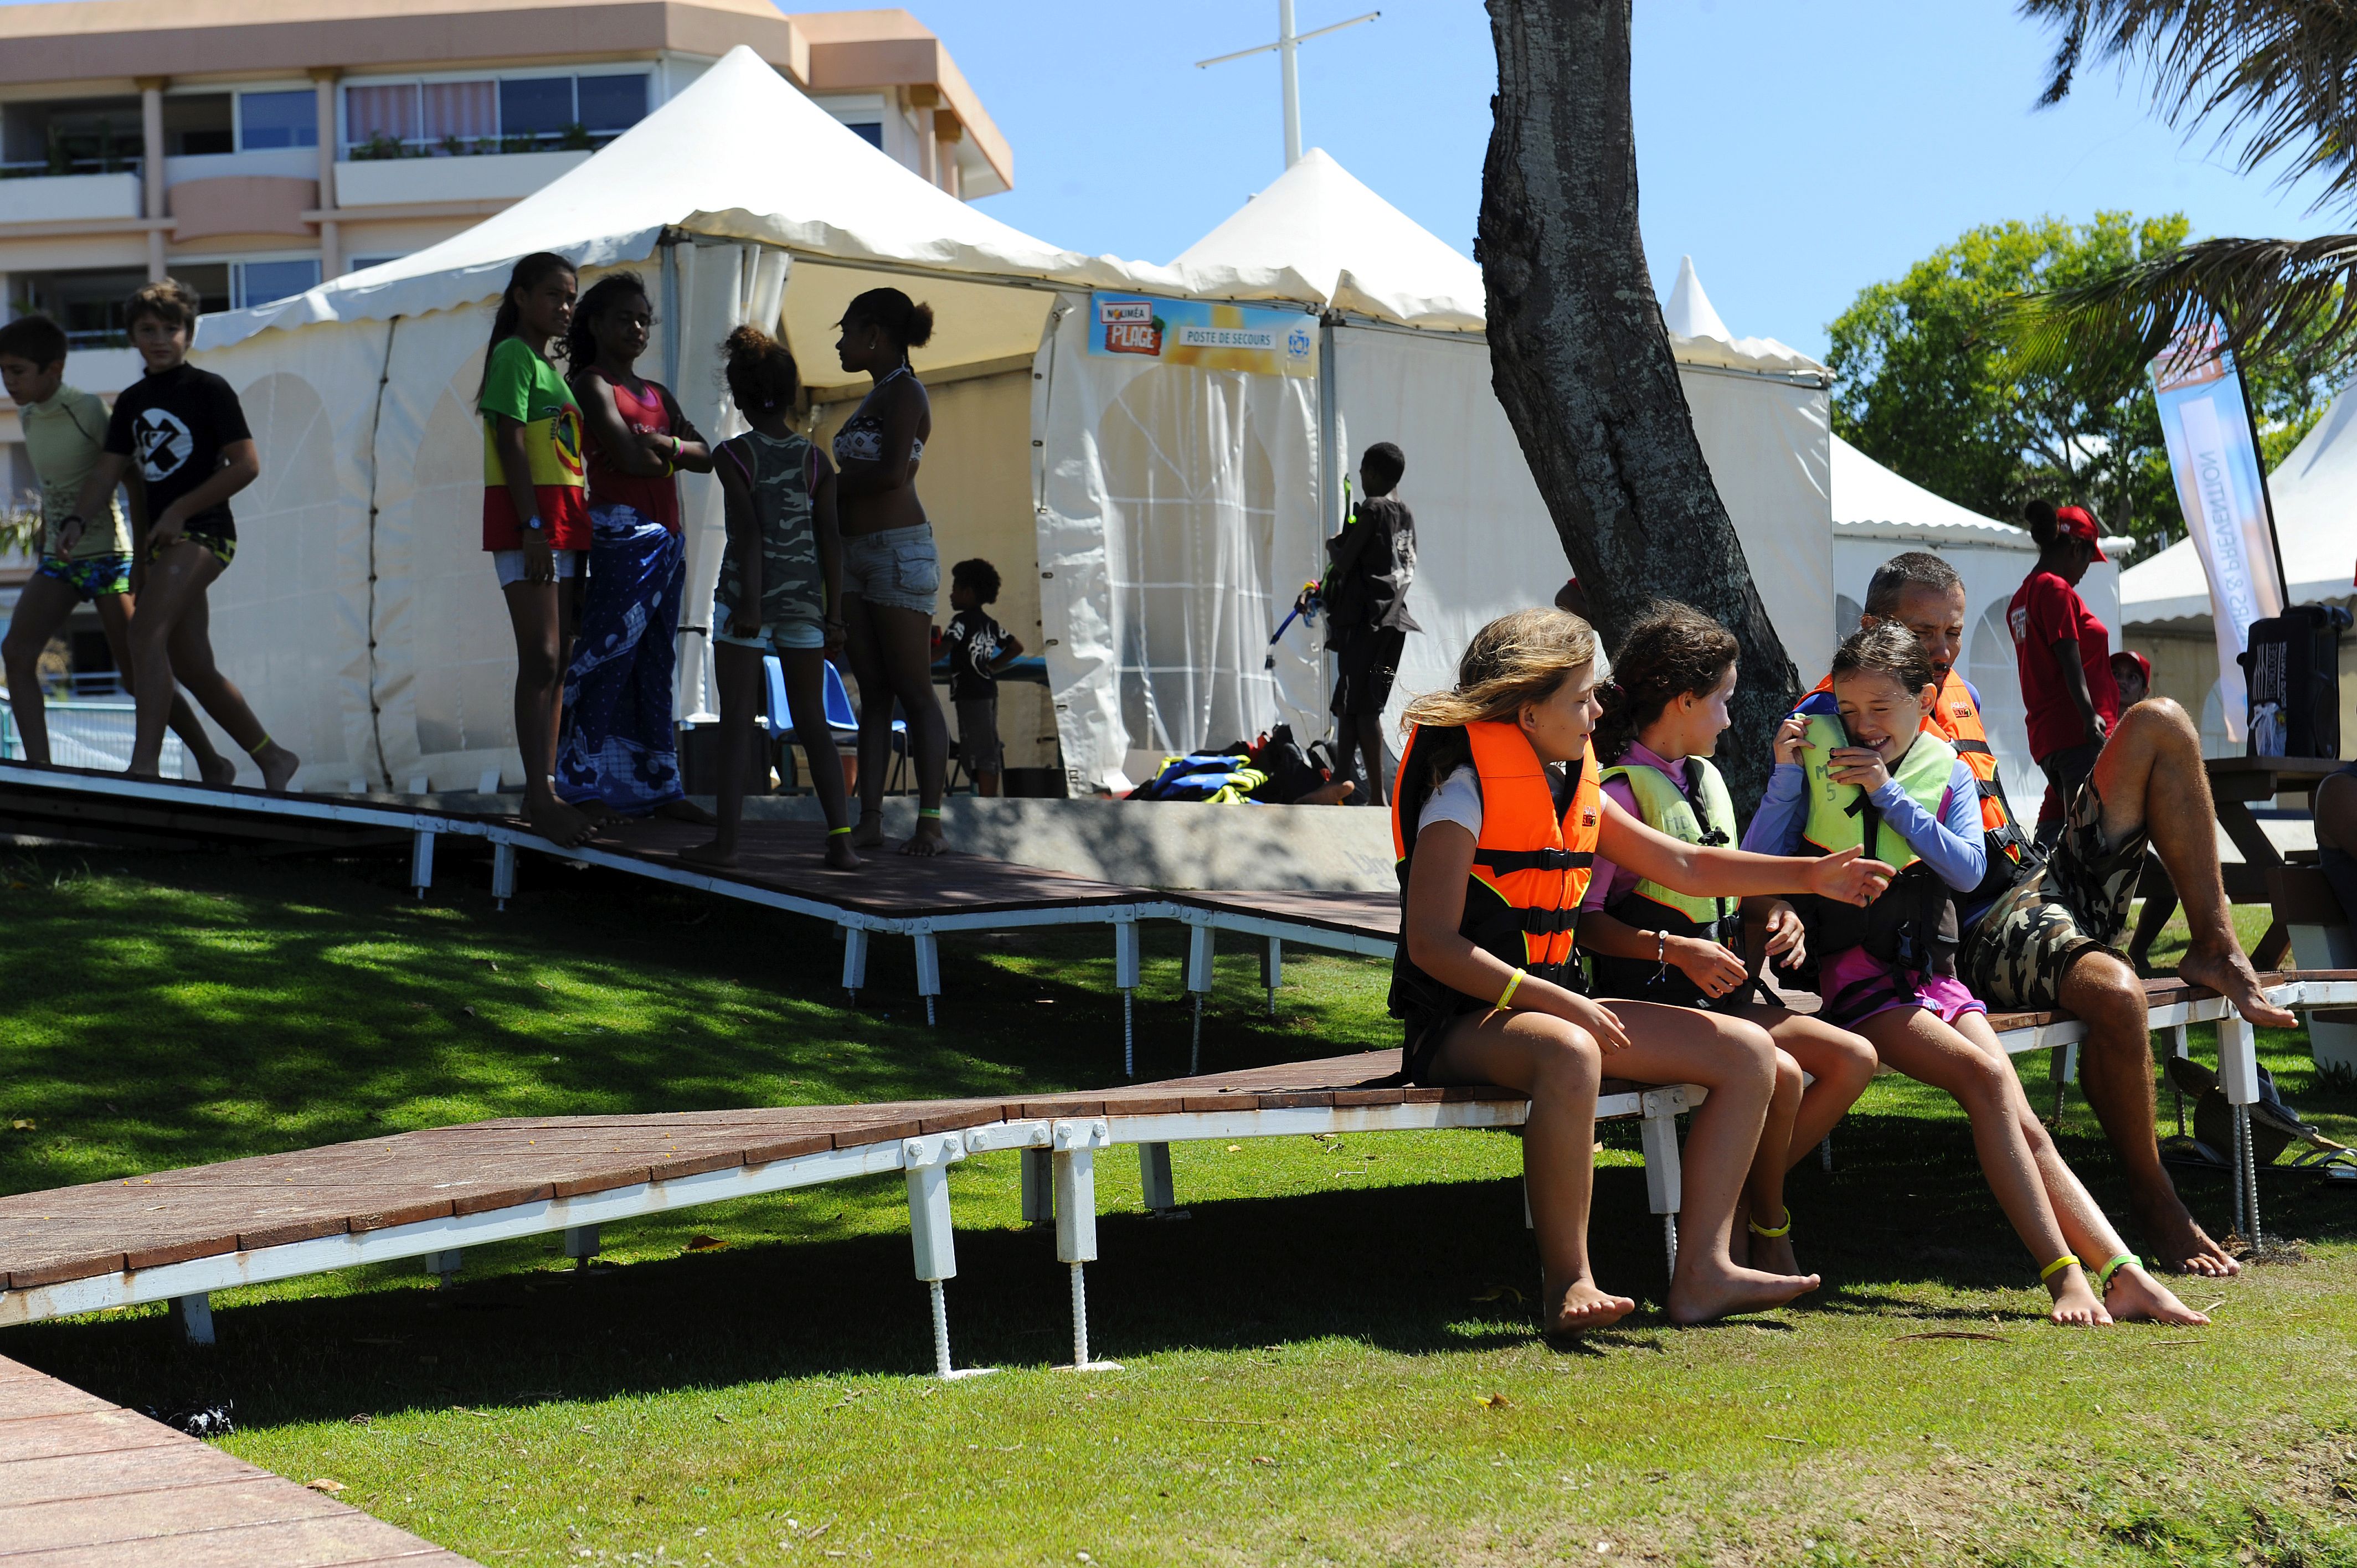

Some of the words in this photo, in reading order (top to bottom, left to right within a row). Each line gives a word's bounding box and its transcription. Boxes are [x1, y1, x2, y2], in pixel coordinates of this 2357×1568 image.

[1107, 307, 1145, 319] NOUMÉA
[1111, 325, 1155, 349] PLAGE
[1187, 331, 1216, 343] POSTE
[1219, 332, 1230, 344] DE
[1233, 333, 1270, 346] SECOURS
[1826, 782, 1836, 801] 5
